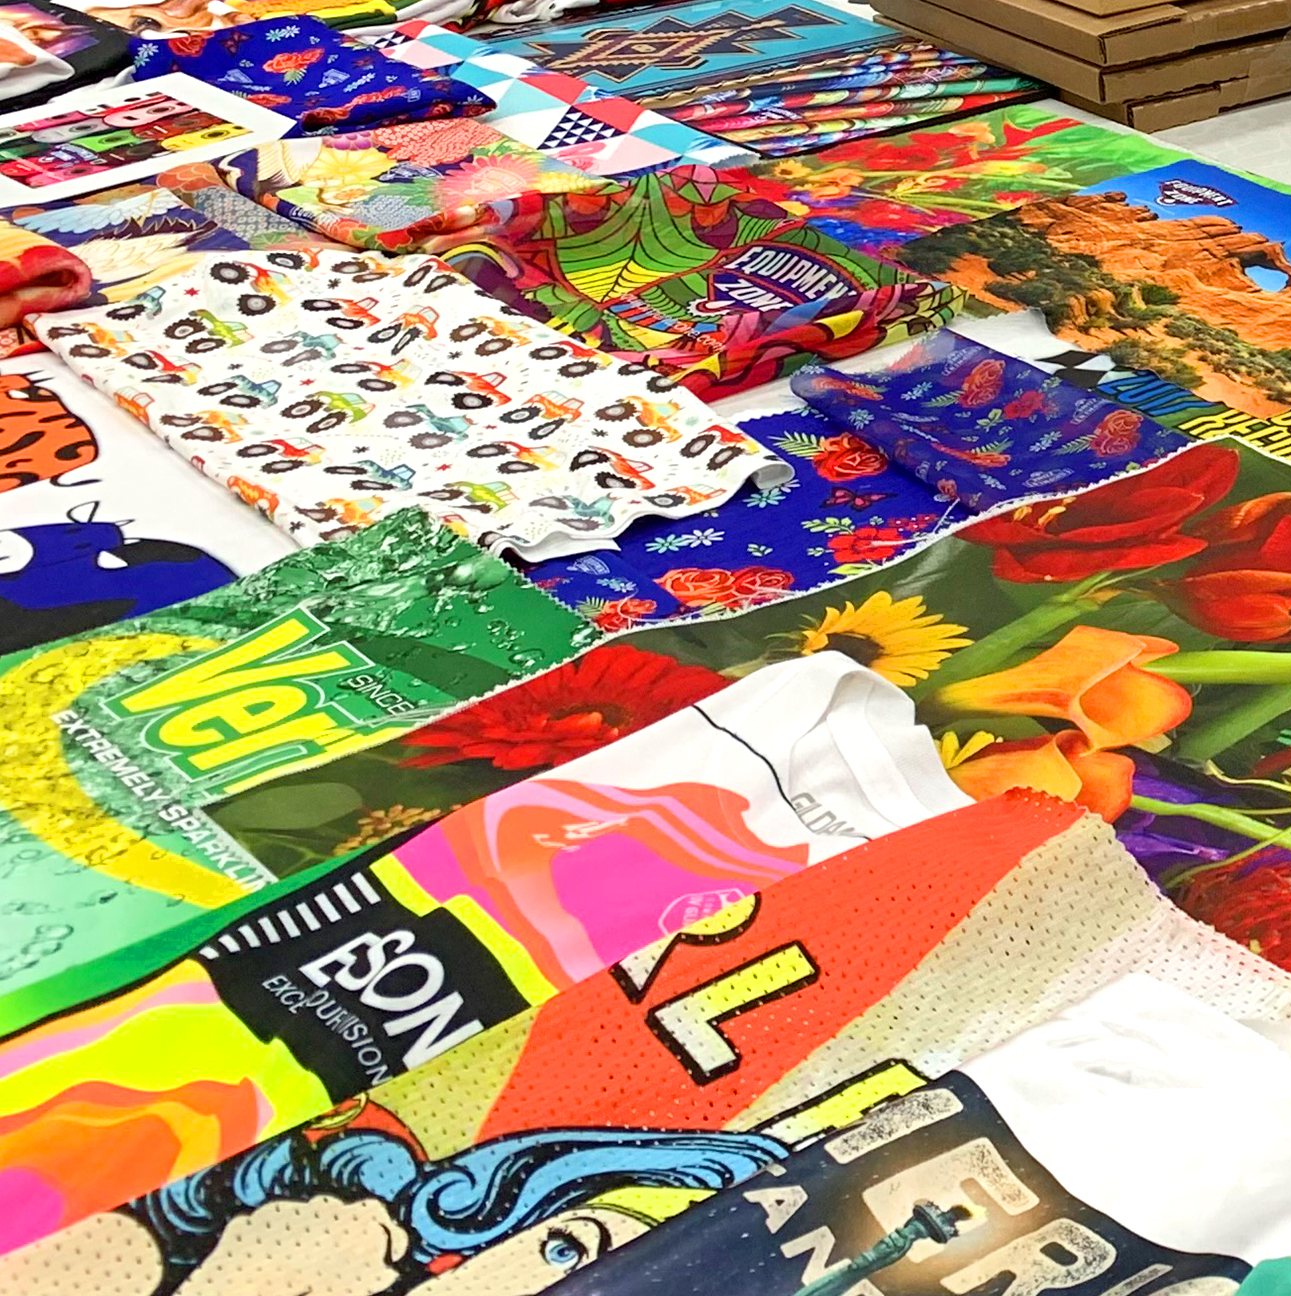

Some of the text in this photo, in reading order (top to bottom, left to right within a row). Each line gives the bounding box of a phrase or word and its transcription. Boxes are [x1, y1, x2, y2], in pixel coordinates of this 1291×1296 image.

[714, 279, 795, 312] ZONE
[724, 245, 859, 300] EQUIPMEN
[347, 674, 415, 717] SINCE
[51, 709, 170, 810] EXTREMELY
